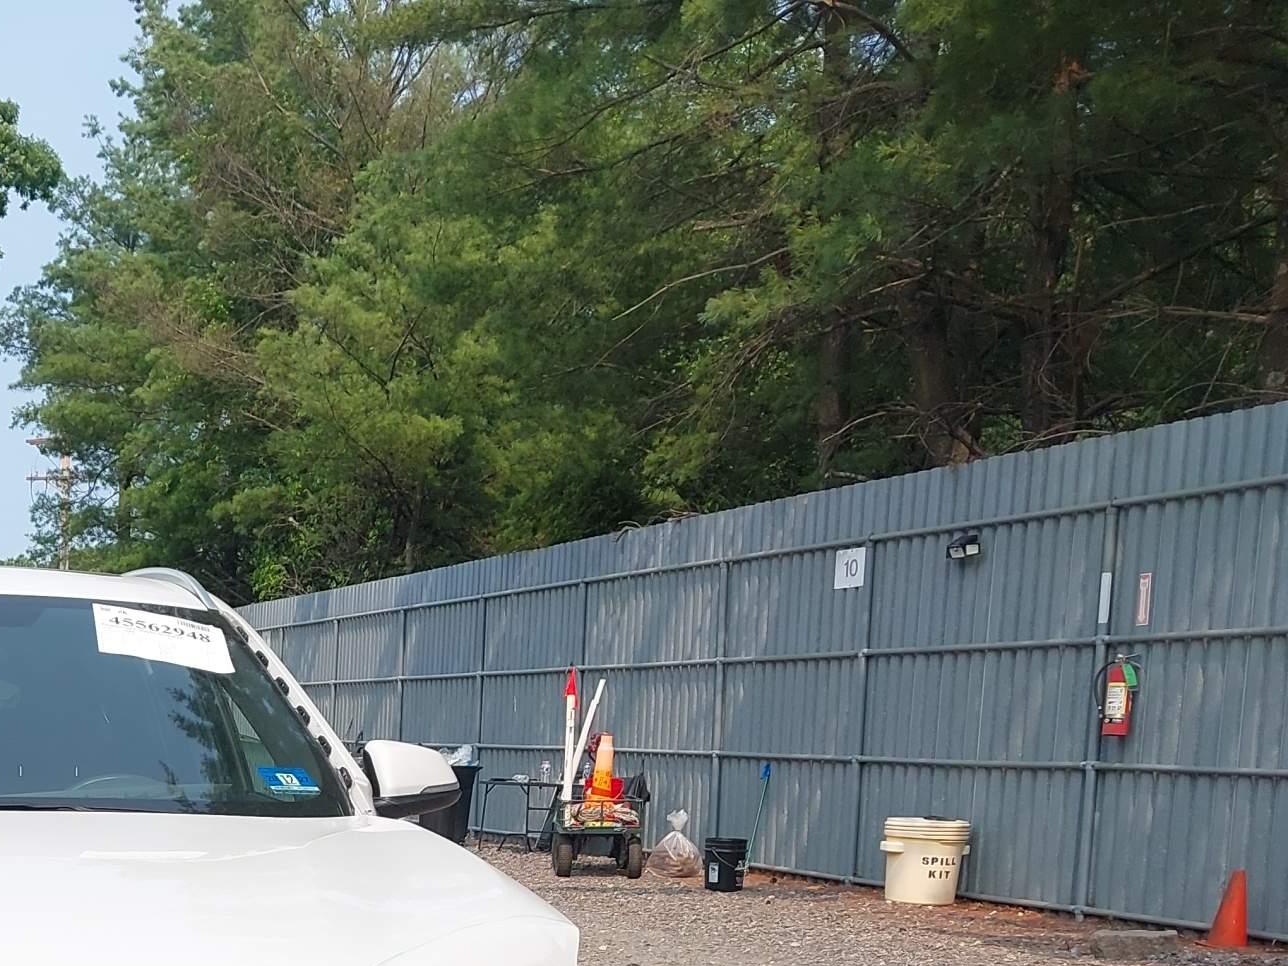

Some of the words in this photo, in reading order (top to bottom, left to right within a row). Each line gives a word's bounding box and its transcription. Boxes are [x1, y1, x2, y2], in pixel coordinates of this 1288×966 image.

[843, 558, 859, 578] 10
[108, 615, 212, 643] 45562948
[279, 774, 298, 785] 12
[921, 856, 957, 866] SPILL
[927, 870, 952, 880] KIT
